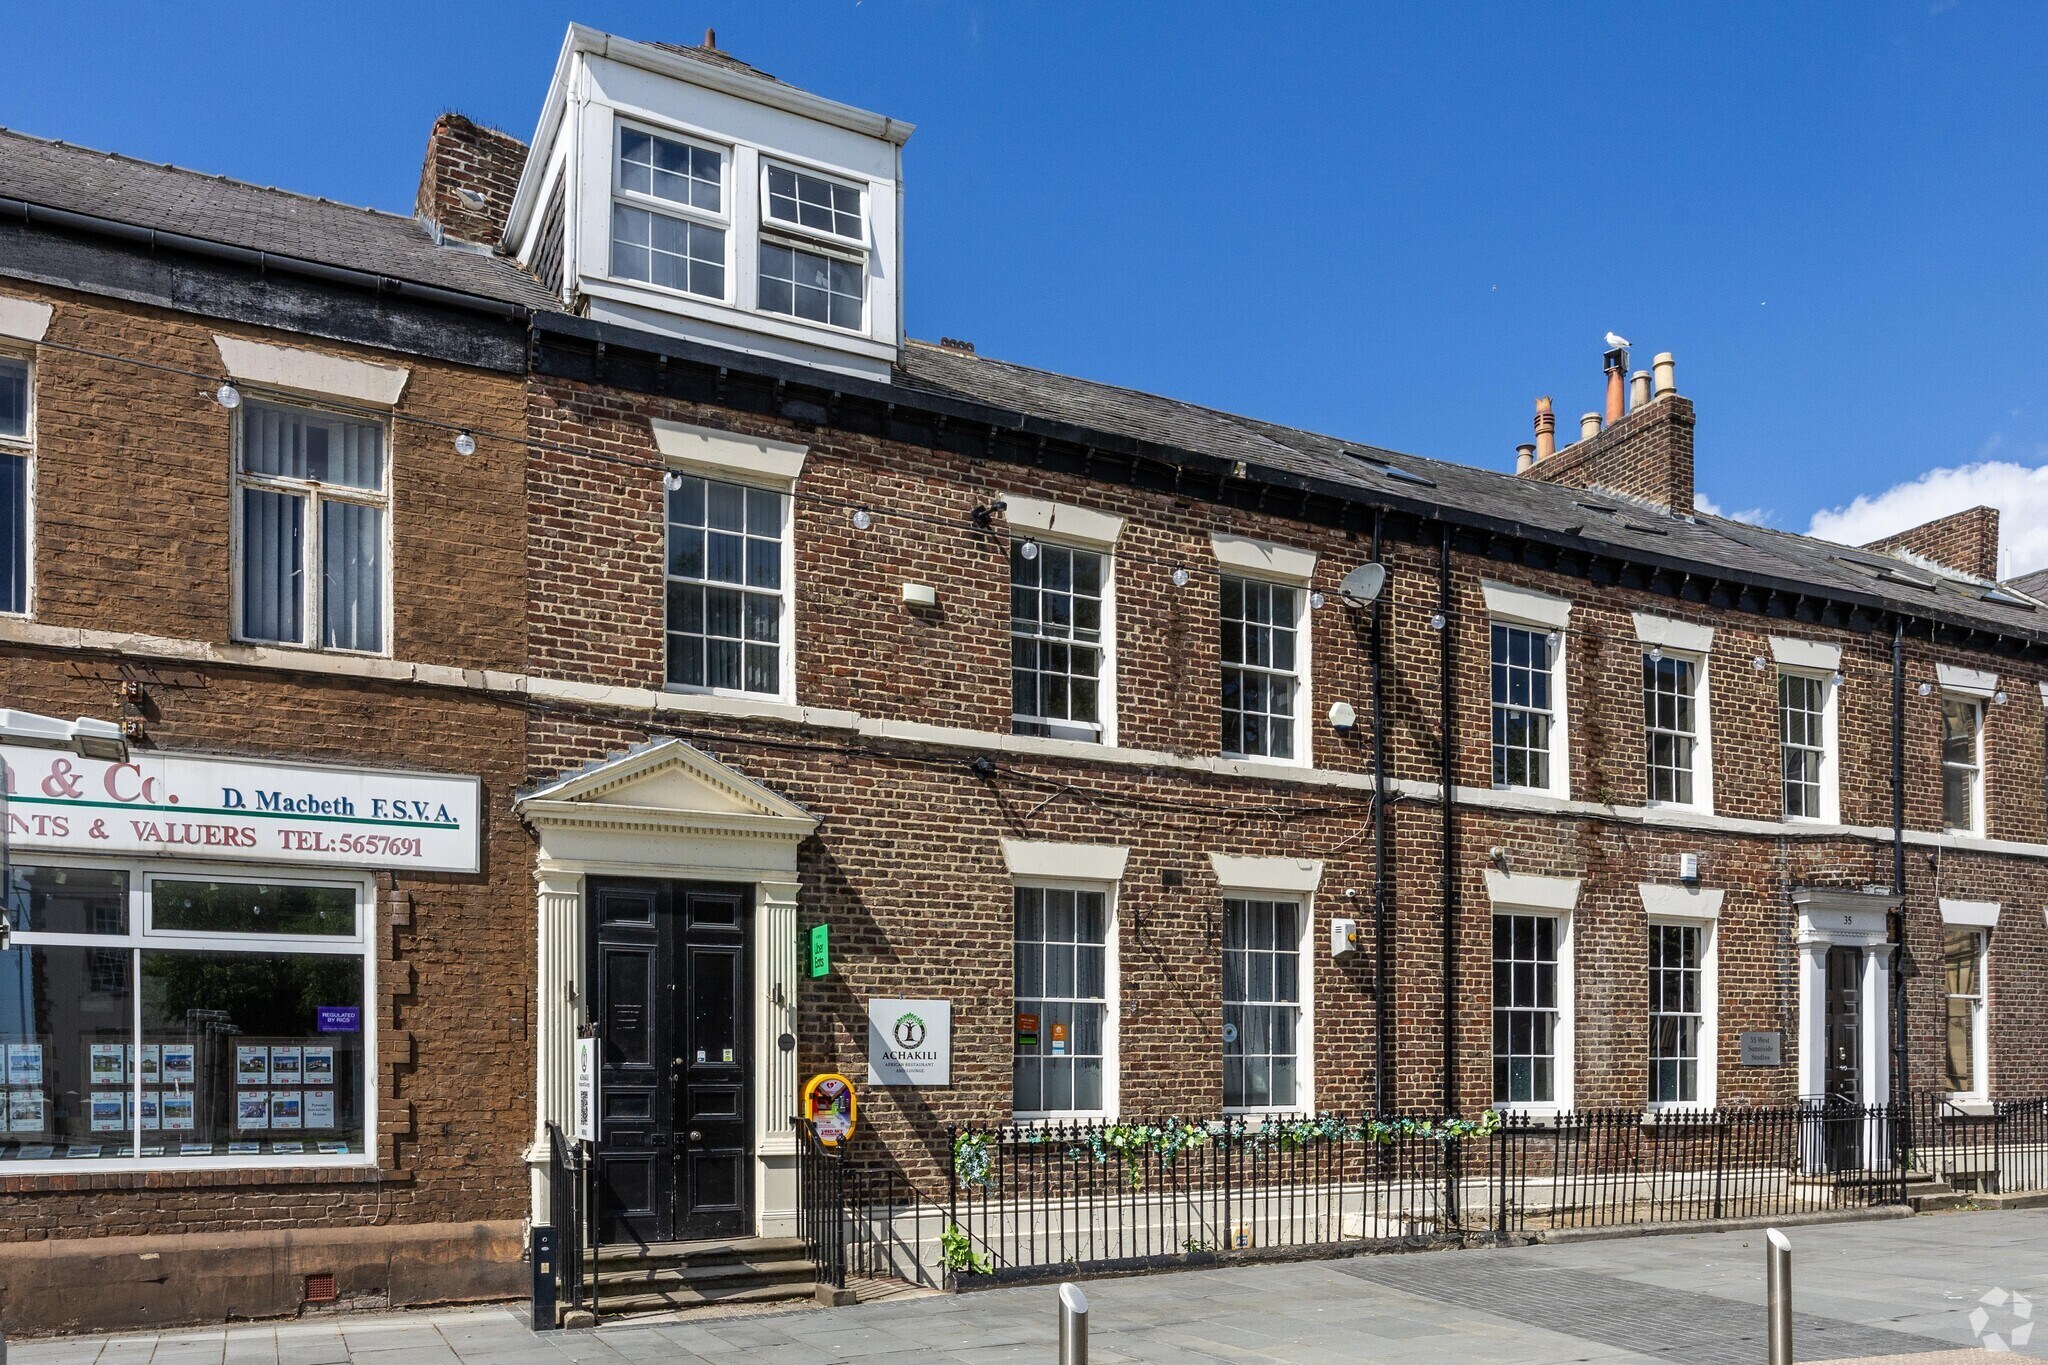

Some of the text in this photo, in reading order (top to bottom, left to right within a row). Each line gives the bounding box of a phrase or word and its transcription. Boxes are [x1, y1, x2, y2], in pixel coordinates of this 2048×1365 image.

[41, 757, 84, 799] &
[222, 787, 459, 823] D. Macbeth F.S.V.A.
[88, 818, 110, 840] &
[129, 820, 257, 847] VALUERS
[1843, 915, 1852, 925] 35
[882, 1051, 937, 1060] ACHAKILI
